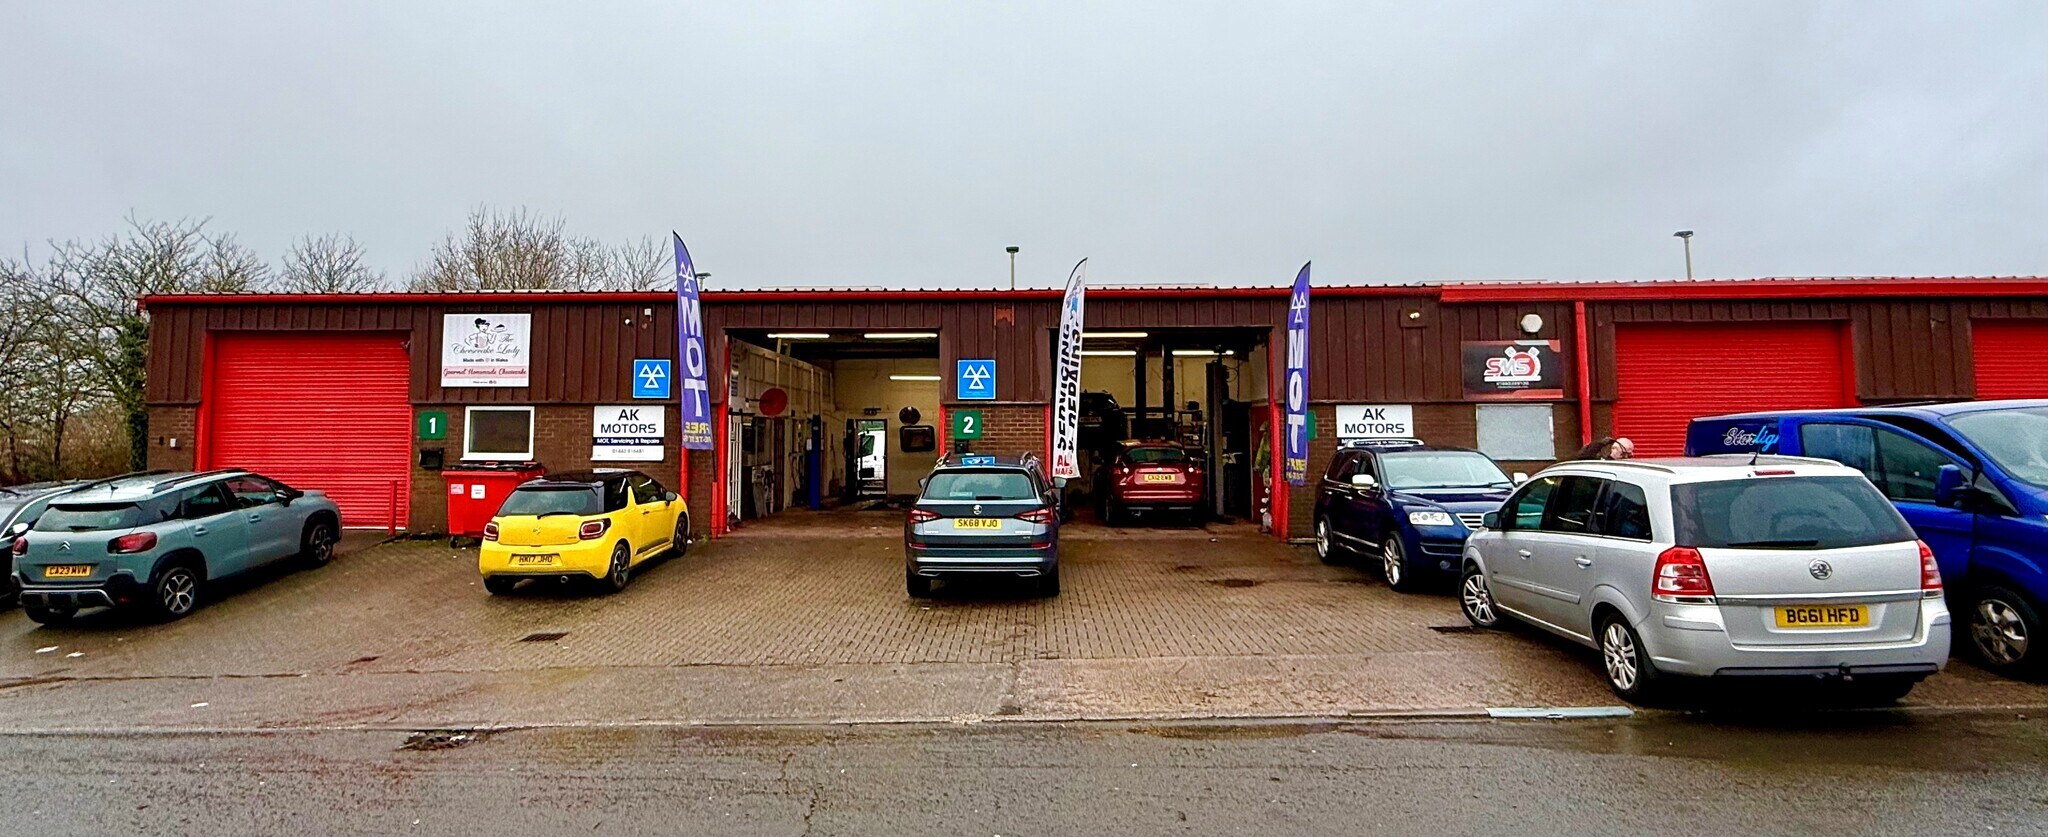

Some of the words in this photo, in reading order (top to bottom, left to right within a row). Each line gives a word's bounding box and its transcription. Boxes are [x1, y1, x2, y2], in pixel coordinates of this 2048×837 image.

[499, 333, 515, 343] The
[451, 343, 495, 355] Cheesecake
[496, 344, 521, 359] Lady
[1484, 357, 1534, 378] SMS
[1288, 328, 1306, 454] MOT
[617, 409, 640, 421] AK
[1362, 408, 1386, 420] AK
[429, 417, 437, 434] 1
[600, 423, 657, 434] MOTORS
[963, 416, 974, 434] 2
[1344, 423, 1406, 434] MOTORS
[958, 520, 980, 528] SK68
[981, 520, 998, 528] YJO
[1785, 609, 1823, 623] BG61
[1827, 608, 1859, 622] HFD
